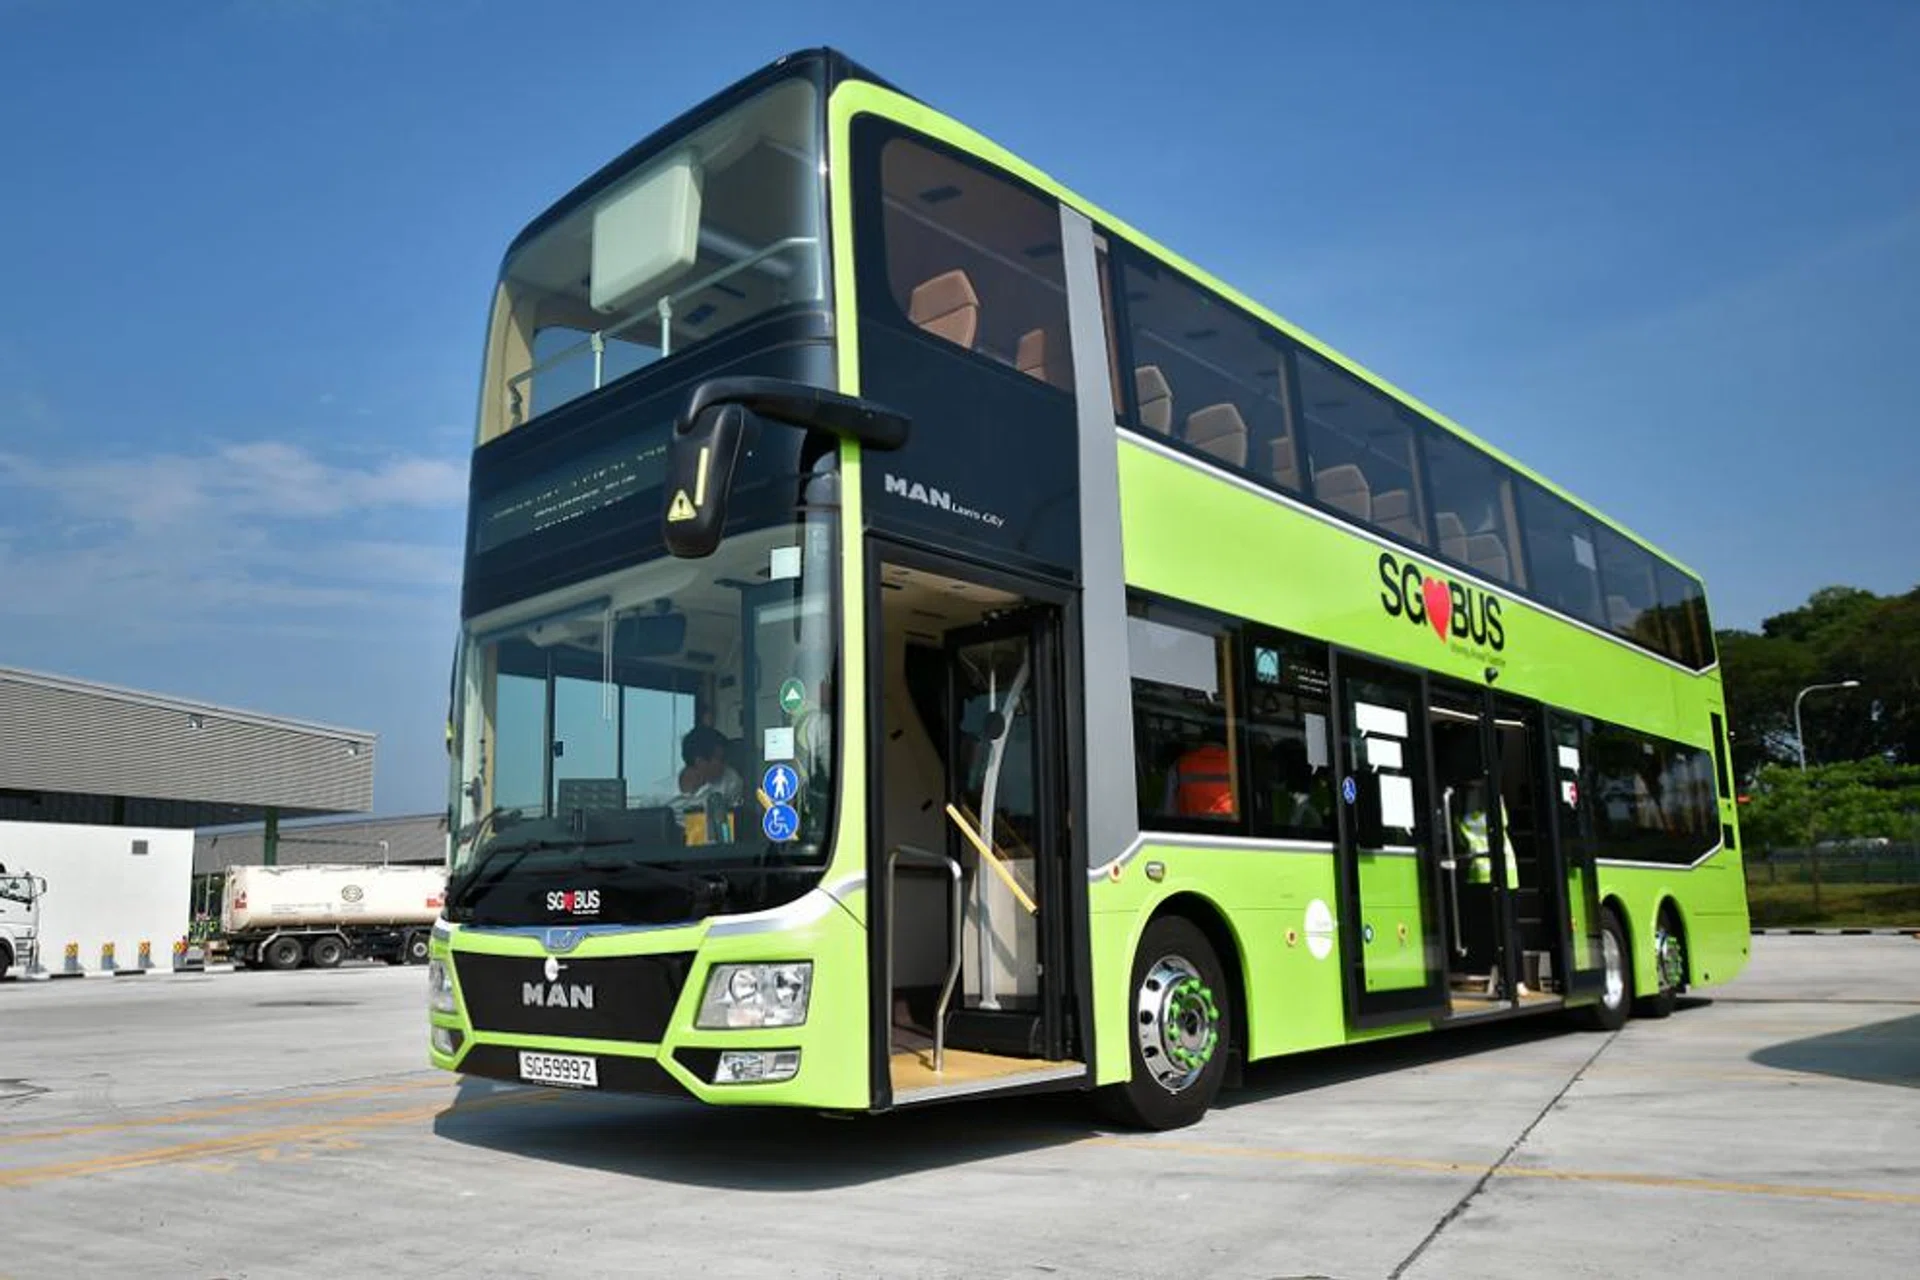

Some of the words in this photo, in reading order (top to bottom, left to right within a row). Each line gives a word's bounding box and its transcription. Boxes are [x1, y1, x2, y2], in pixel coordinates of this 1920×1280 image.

[884, 473, 951, 511] MAN
[522, 982, 594, 1009] MAN
[524, 1055, 591, 1081] SG5999Z
